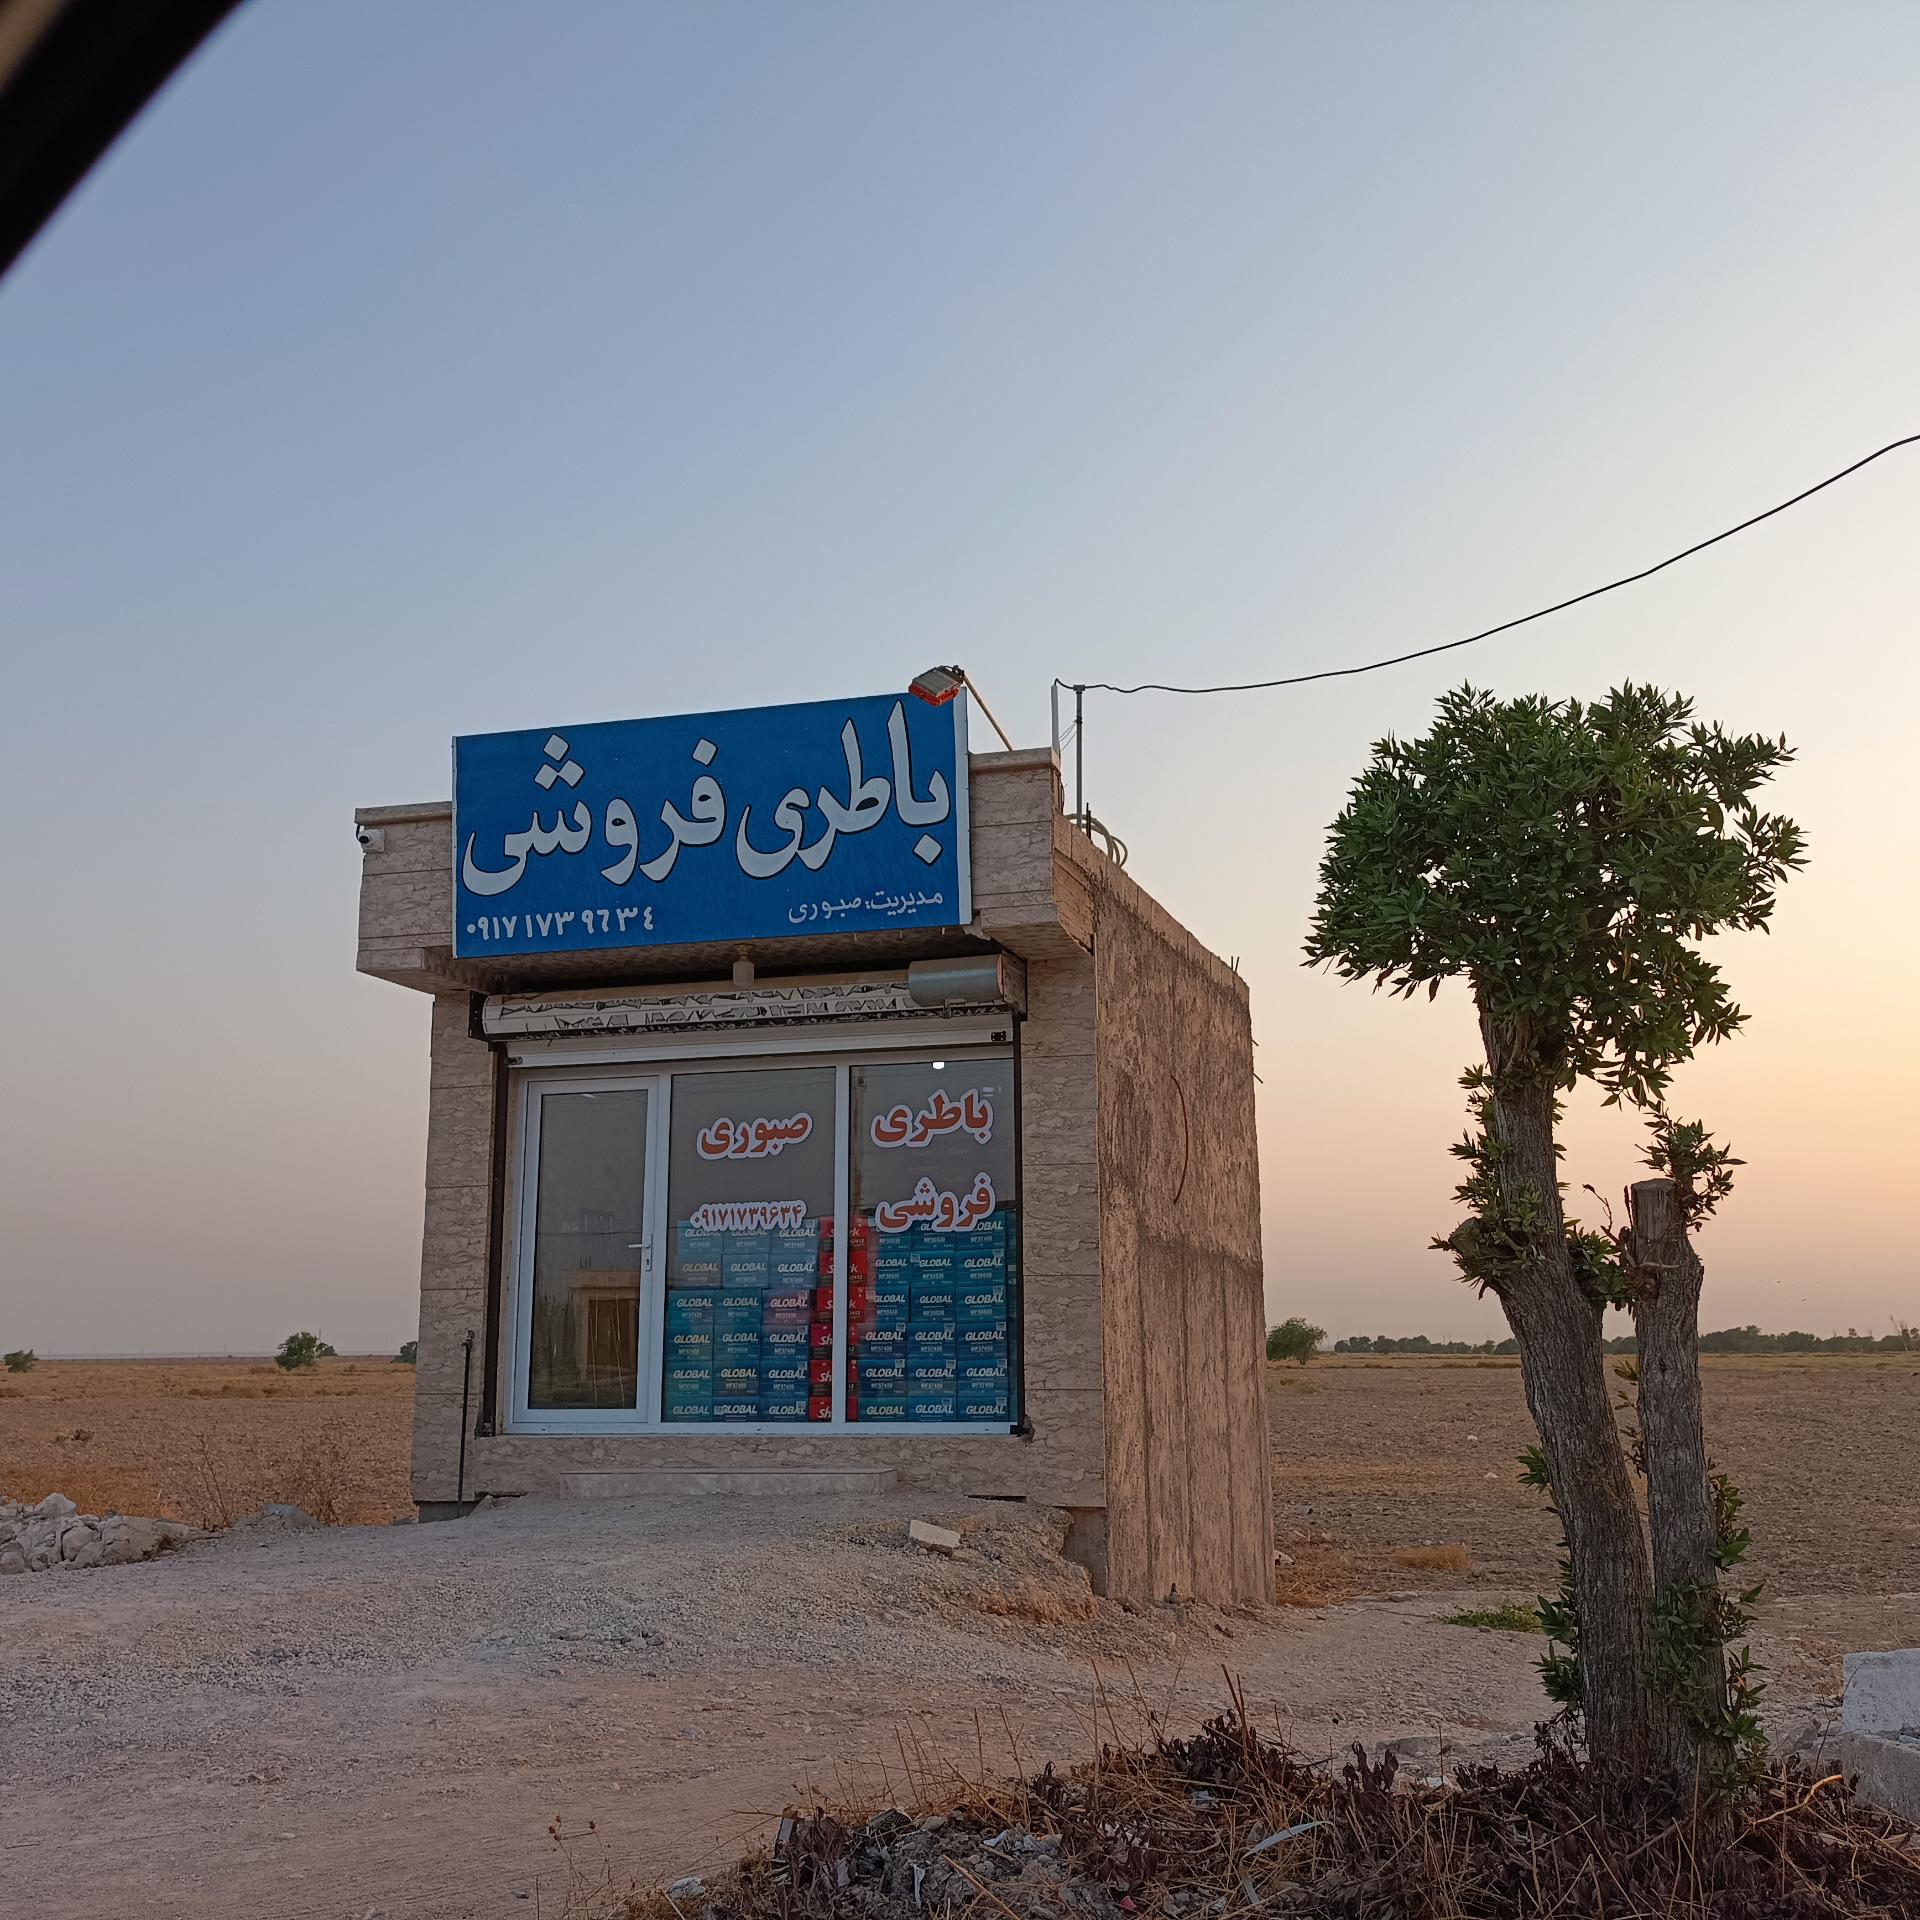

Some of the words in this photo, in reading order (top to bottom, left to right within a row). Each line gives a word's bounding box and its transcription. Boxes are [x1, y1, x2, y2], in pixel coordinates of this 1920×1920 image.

[736, 698, 950, 879] باطری
[462, 733, 726, 896] فروشی
[788, 898, 862, 924] صبوری
[871, 1088, 994, 1147] باطری
[697, 1112, 813, 1159] صبوری
[875, 1172, 996, 1233] فروشی
[975, 1222, 1003, 1230] OBAL
[779, 1228, 816, 1237] GLOBAL
[731, 1262, 767, 1272] GLOBAL
[875, 1258, 907, 1267] GLOBAL
[919, 1258, 952, 1267] GLOBAL
[964, 1257, 1003, 1268] GLOBAL
[683, 1263, 719, 1272] GLOBAL
[778, 1263, 814, 1273] GLOBAL
[723, 1298, 759, 1307] GLOBAL
[770, 1298, 807, 1308] GLOBAL
[874, 1294, 905, 1303] GLOBAL
[920, 1295, 952, 1303] GLOBAL
[965, 1294, 1003, 1304] GLOBAL
[677, 1299, 712, 1308] GLOBAL
[674, 1334, 710, 1343] GLOBAL
[723, 1333, 758, 1342] GLOBAL
[769, 1334, 806, 1343] GLOBAL
[866, 1332, 903, 1341] GLOBAL
[915, 1331, 953, 1341] GLOBAL
[965, 1331, 1004, 1341] GLOBAL
[674, 1369, 710, 1378] GLOBAL
[721, 1369, 757, 1378] GLOBAL
[768, 1369, 805, 1379] GLOBAL
[866, 1368, 904, 1377] GLOBAL
[916, 1368, 954, 1378] GLOBAL
[966, 1368, 1005, 1377] GLOBAL
[673, 1406, 709, 1415] GLOBAL
[721, 1405, 757, 1414] GLOBAL
[769, 1405, 805, 1415] GLOBAL
[867, 1406, 904, 1415] GLOBAL
[916, 1405, 953, 1414] GLOBAL
[966, 1405, 1005, 1415] GLOBAL
